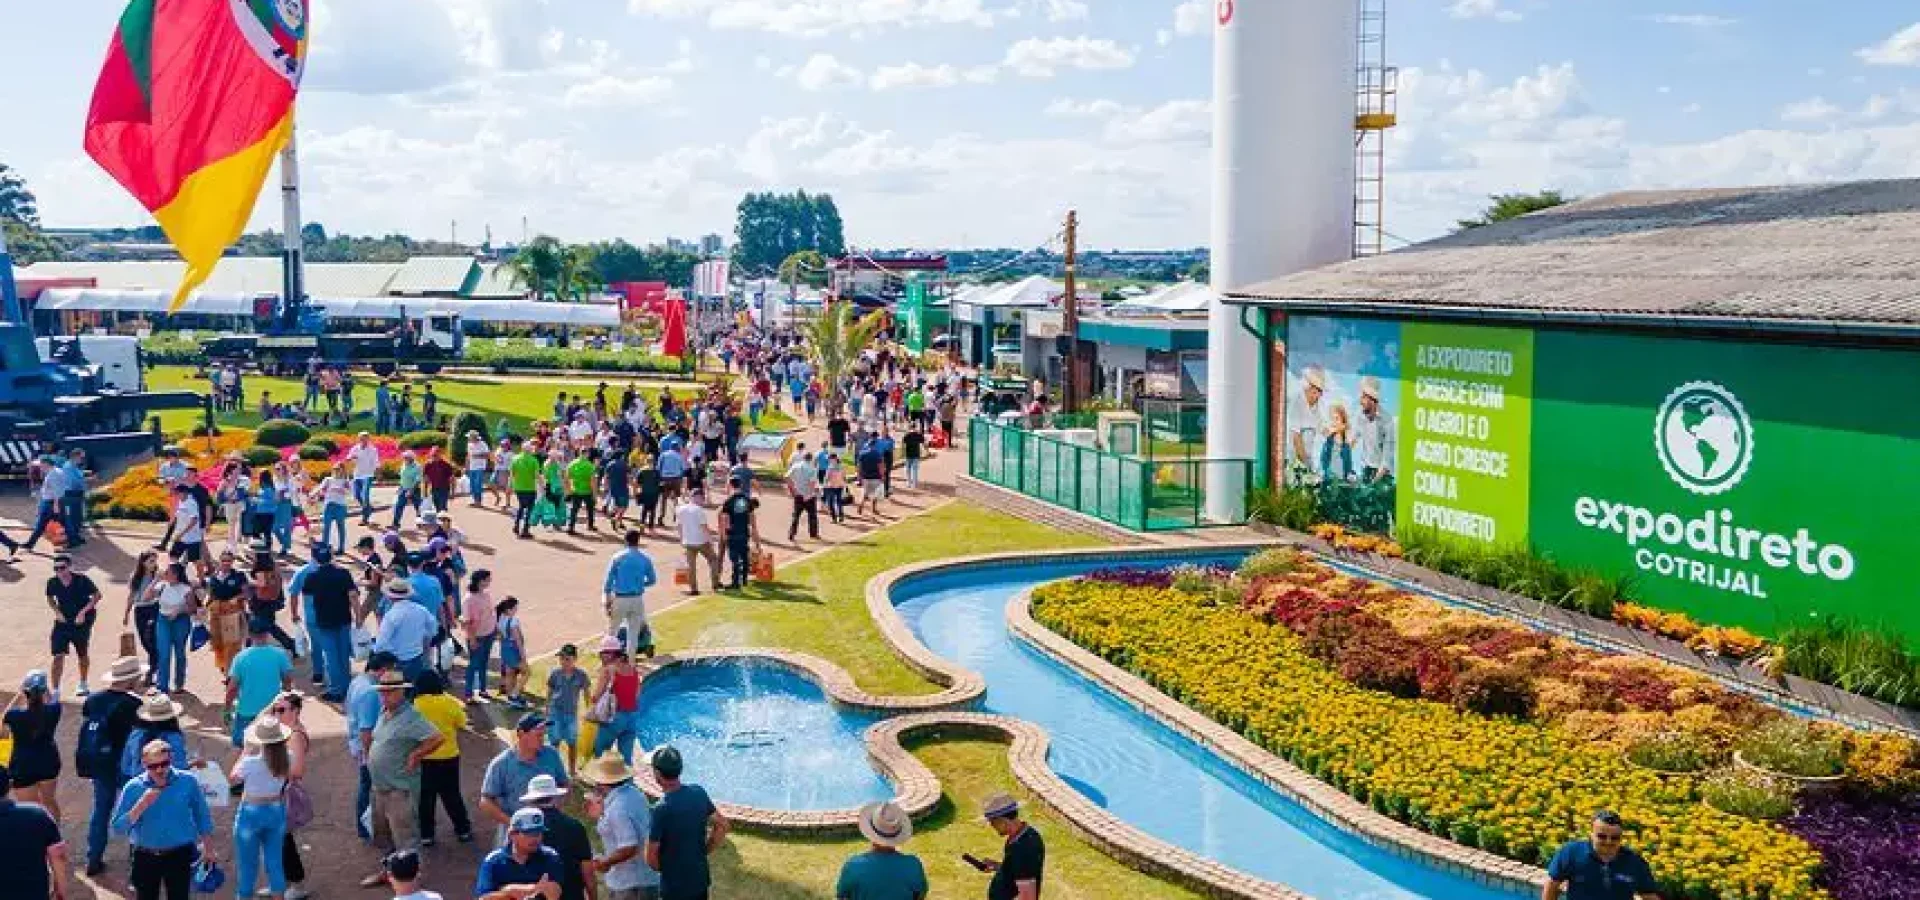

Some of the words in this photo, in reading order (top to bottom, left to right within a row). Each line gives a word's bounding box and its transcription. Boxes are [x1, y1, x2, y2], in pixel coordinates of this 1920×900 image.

[1416, 376, 1468, 405] CRESCE
[1469, 382, 1504, 410] COM
[1416, 407, 1426, 430] O
[1427, 409, 1464, 436] AGRO
[1467, 413, 1477, 437] E
[1478, 416, 1488, 439] O
[1414, 439, 1451, 467] AGRO
[1454, 446, 1509, 477] CRESCE
[1414, 470, 1446, 497] COM
[1447, 476, 1458, 499] A
[1413, 501, 1495, 542] EXPODIRETO
[1574, 496, 1854, 580] expodireto
[1635, 548, 1768, 599] COTRIJAL
